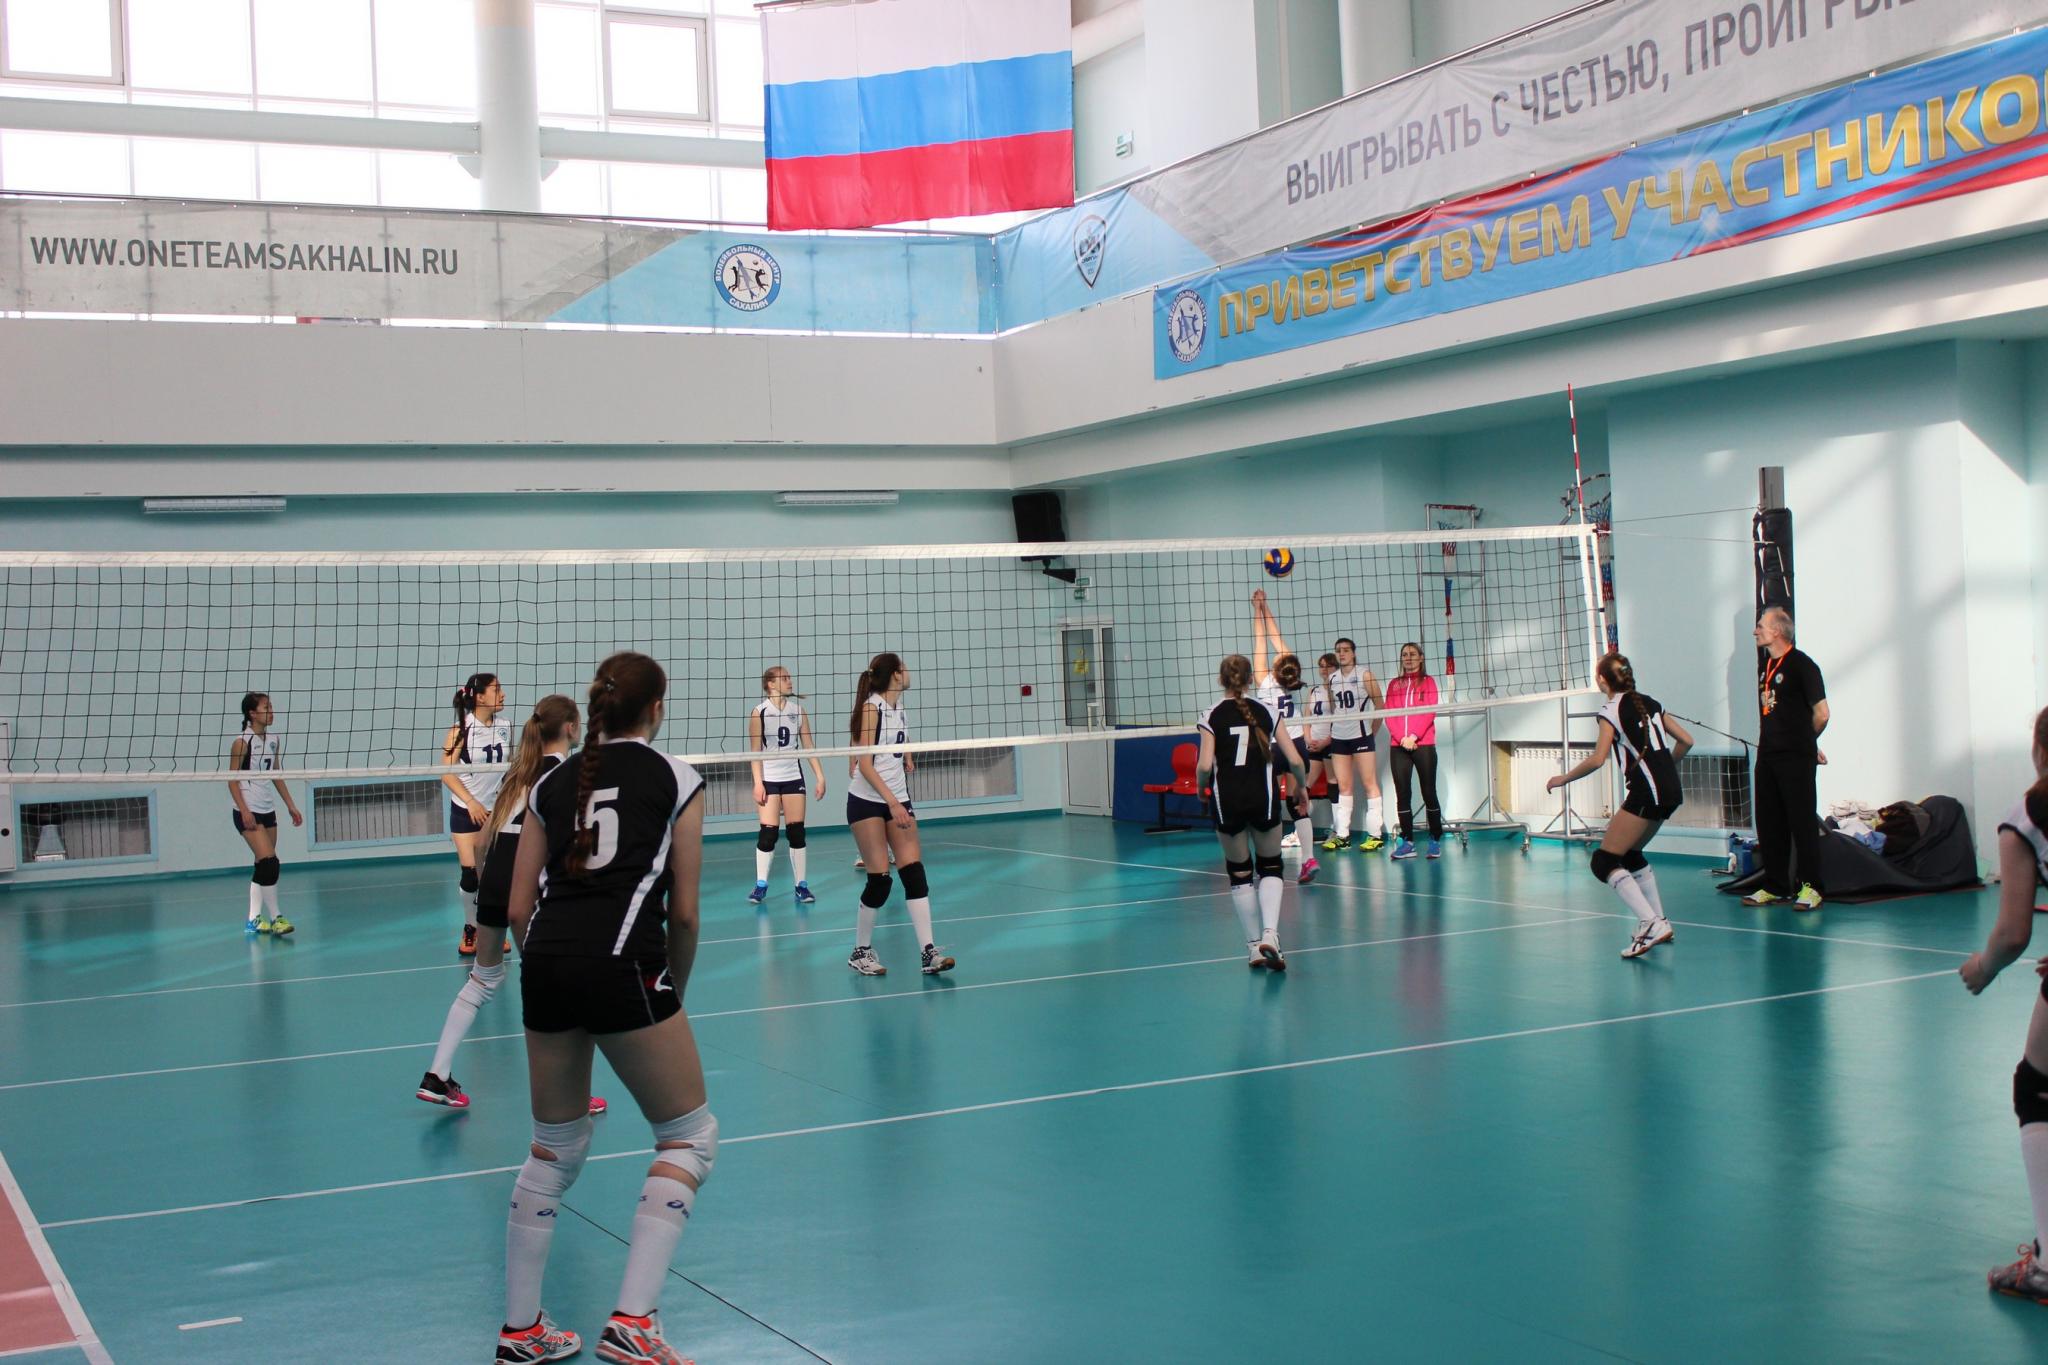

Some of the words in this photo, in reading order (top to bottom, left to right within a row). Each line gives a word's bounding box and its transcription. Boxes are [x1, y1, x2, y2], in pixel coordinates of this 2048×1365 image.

[1286, 103, 1481, 206] ВЫИГРЫВАТЬ
[1491, 90, 1511, 138] С
[1520, 38, 1670, 124] ЧЕСТЬЮ,
[1218, 194, 1592, 339] ПРИВЕТСТВУЕМ
[1602, 73, 2048, 240] УЧАСТНИКО
[30, 236, 458, 275] WWW.ONETEAMSAKHALIN.RU
[715, 244, 767, 282] ВОЛЕЙБОЛЬНЫЙ
[766, 254, 781, 285] ЦЕНТР
[729, 297, 769, 311] САХАЛИН
[1277, 694, 1295, 719] 5
[1313, 701, 1323, 715] 4
[1335, 690, 1355, 709] 10
[777, 726, 791, 747] 9
[1229, 725, 1249, 767] 7
[263, 758, 271, 770] 7
[482, 742, 503, 763] 11
[575, 786, 620, 871] 5
